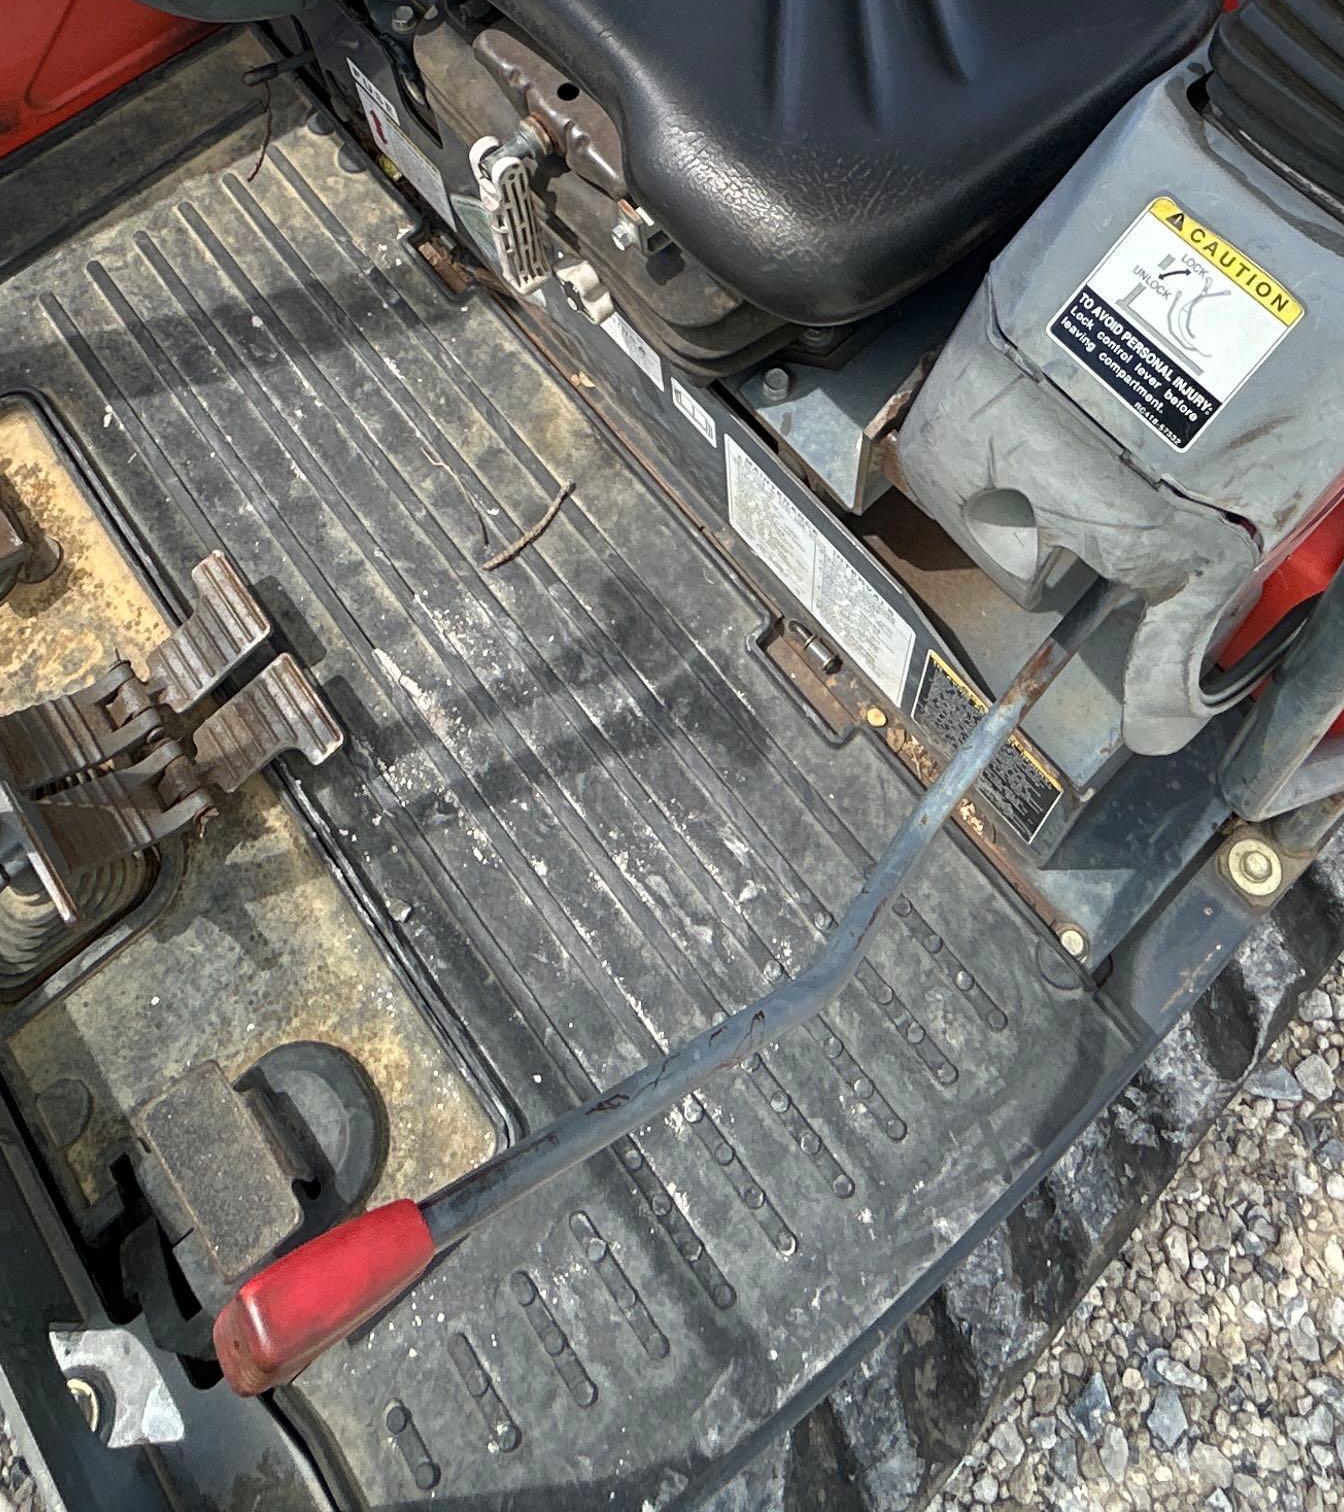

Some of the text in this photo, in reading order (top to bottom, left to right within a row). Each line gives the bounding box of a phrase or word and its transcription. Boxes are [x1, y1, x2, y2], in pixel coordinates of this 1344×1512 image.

[1133, 265, 1172, 300] UNLOCK
[1181, 253, 1209, 279] LOCK
[1190, 228, 1290, 312] CAUTION
[1060, 316, 1164, 414] leaving compartment.
[1071, 306, 1198, 422] Lock control lever before
[1078, 292, 1095, 310] TO
[1091, 306, 1124, 336] AVOID
[1121, 331, 1173, 382] PERSONAL
